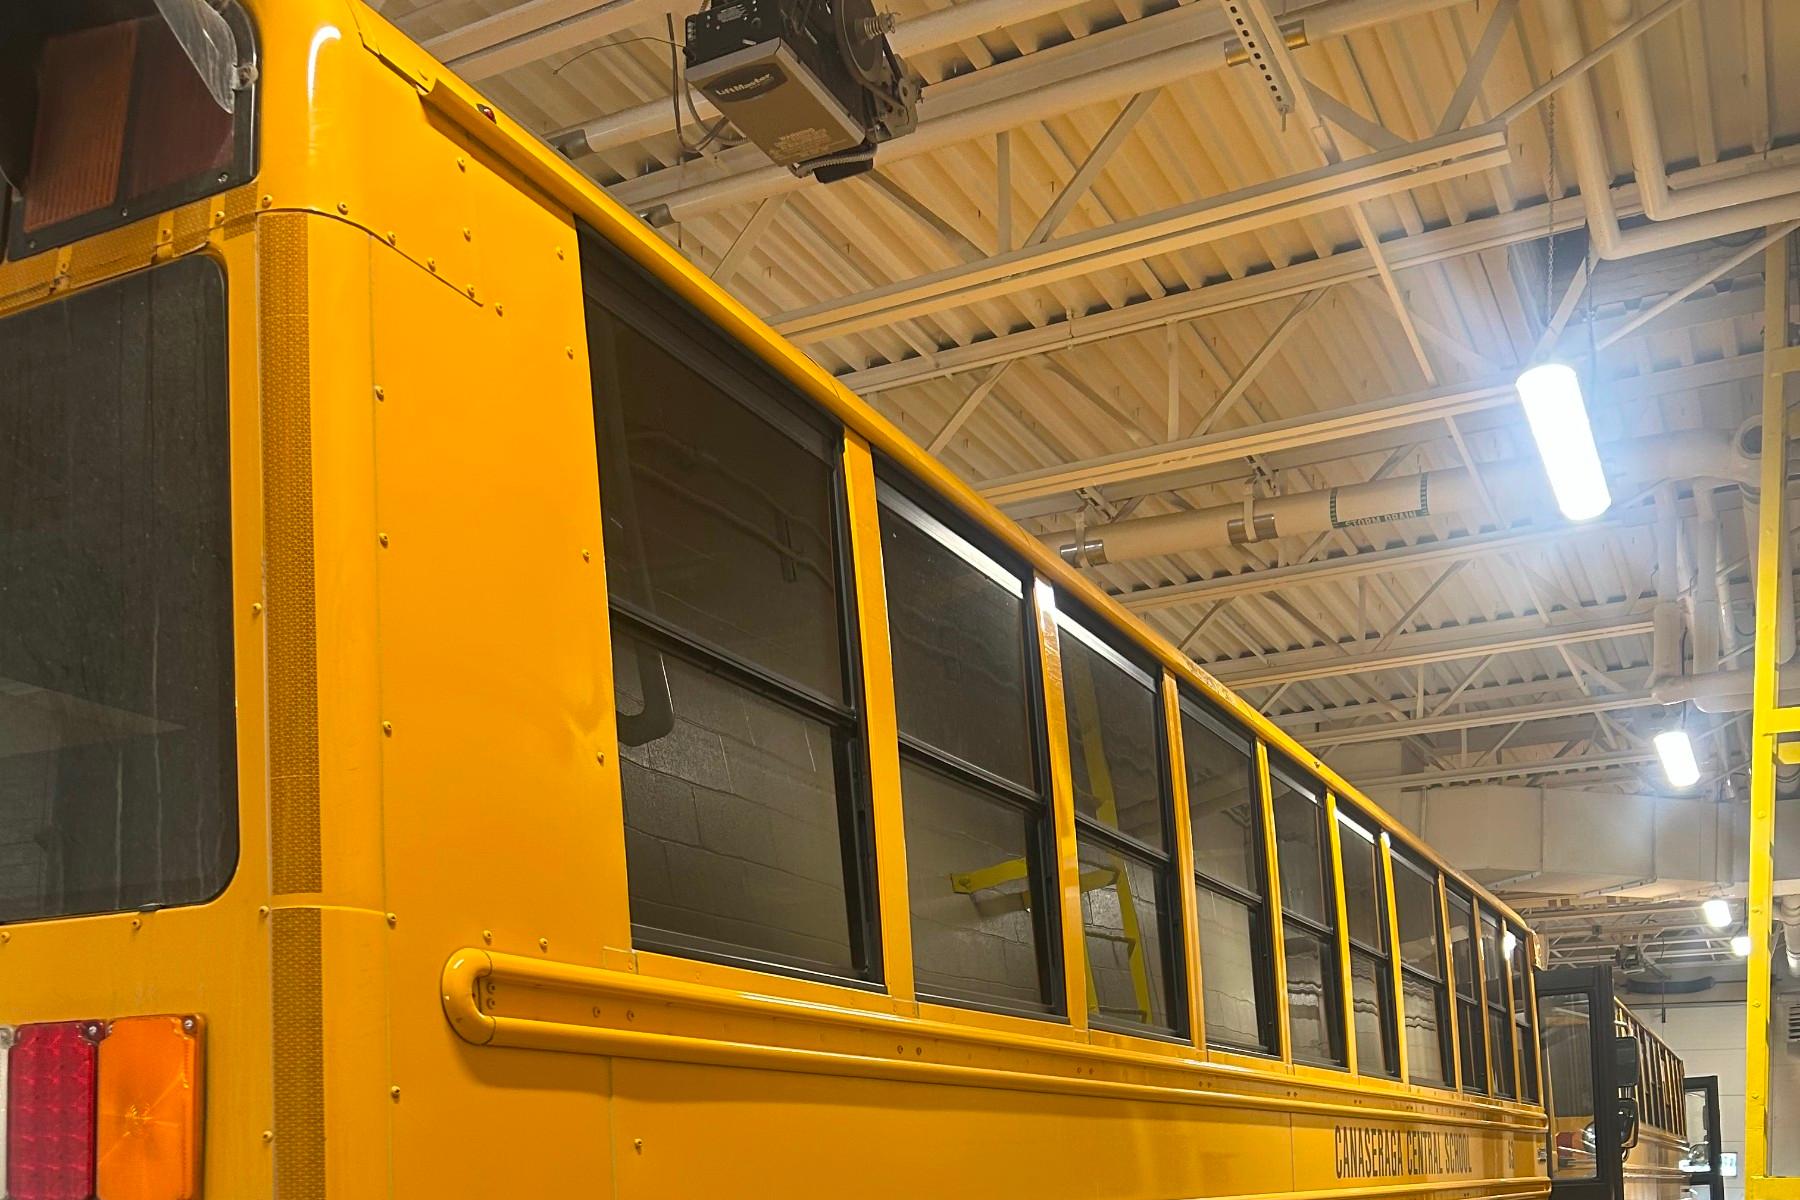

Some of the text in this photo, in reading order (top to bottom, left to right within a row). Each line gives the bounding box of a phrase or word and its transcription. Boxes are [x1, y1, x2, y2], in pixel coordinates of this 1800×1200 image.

[1334, 1125, 1472, 1179] CANASERAGA CENTRAL SCHOOL
